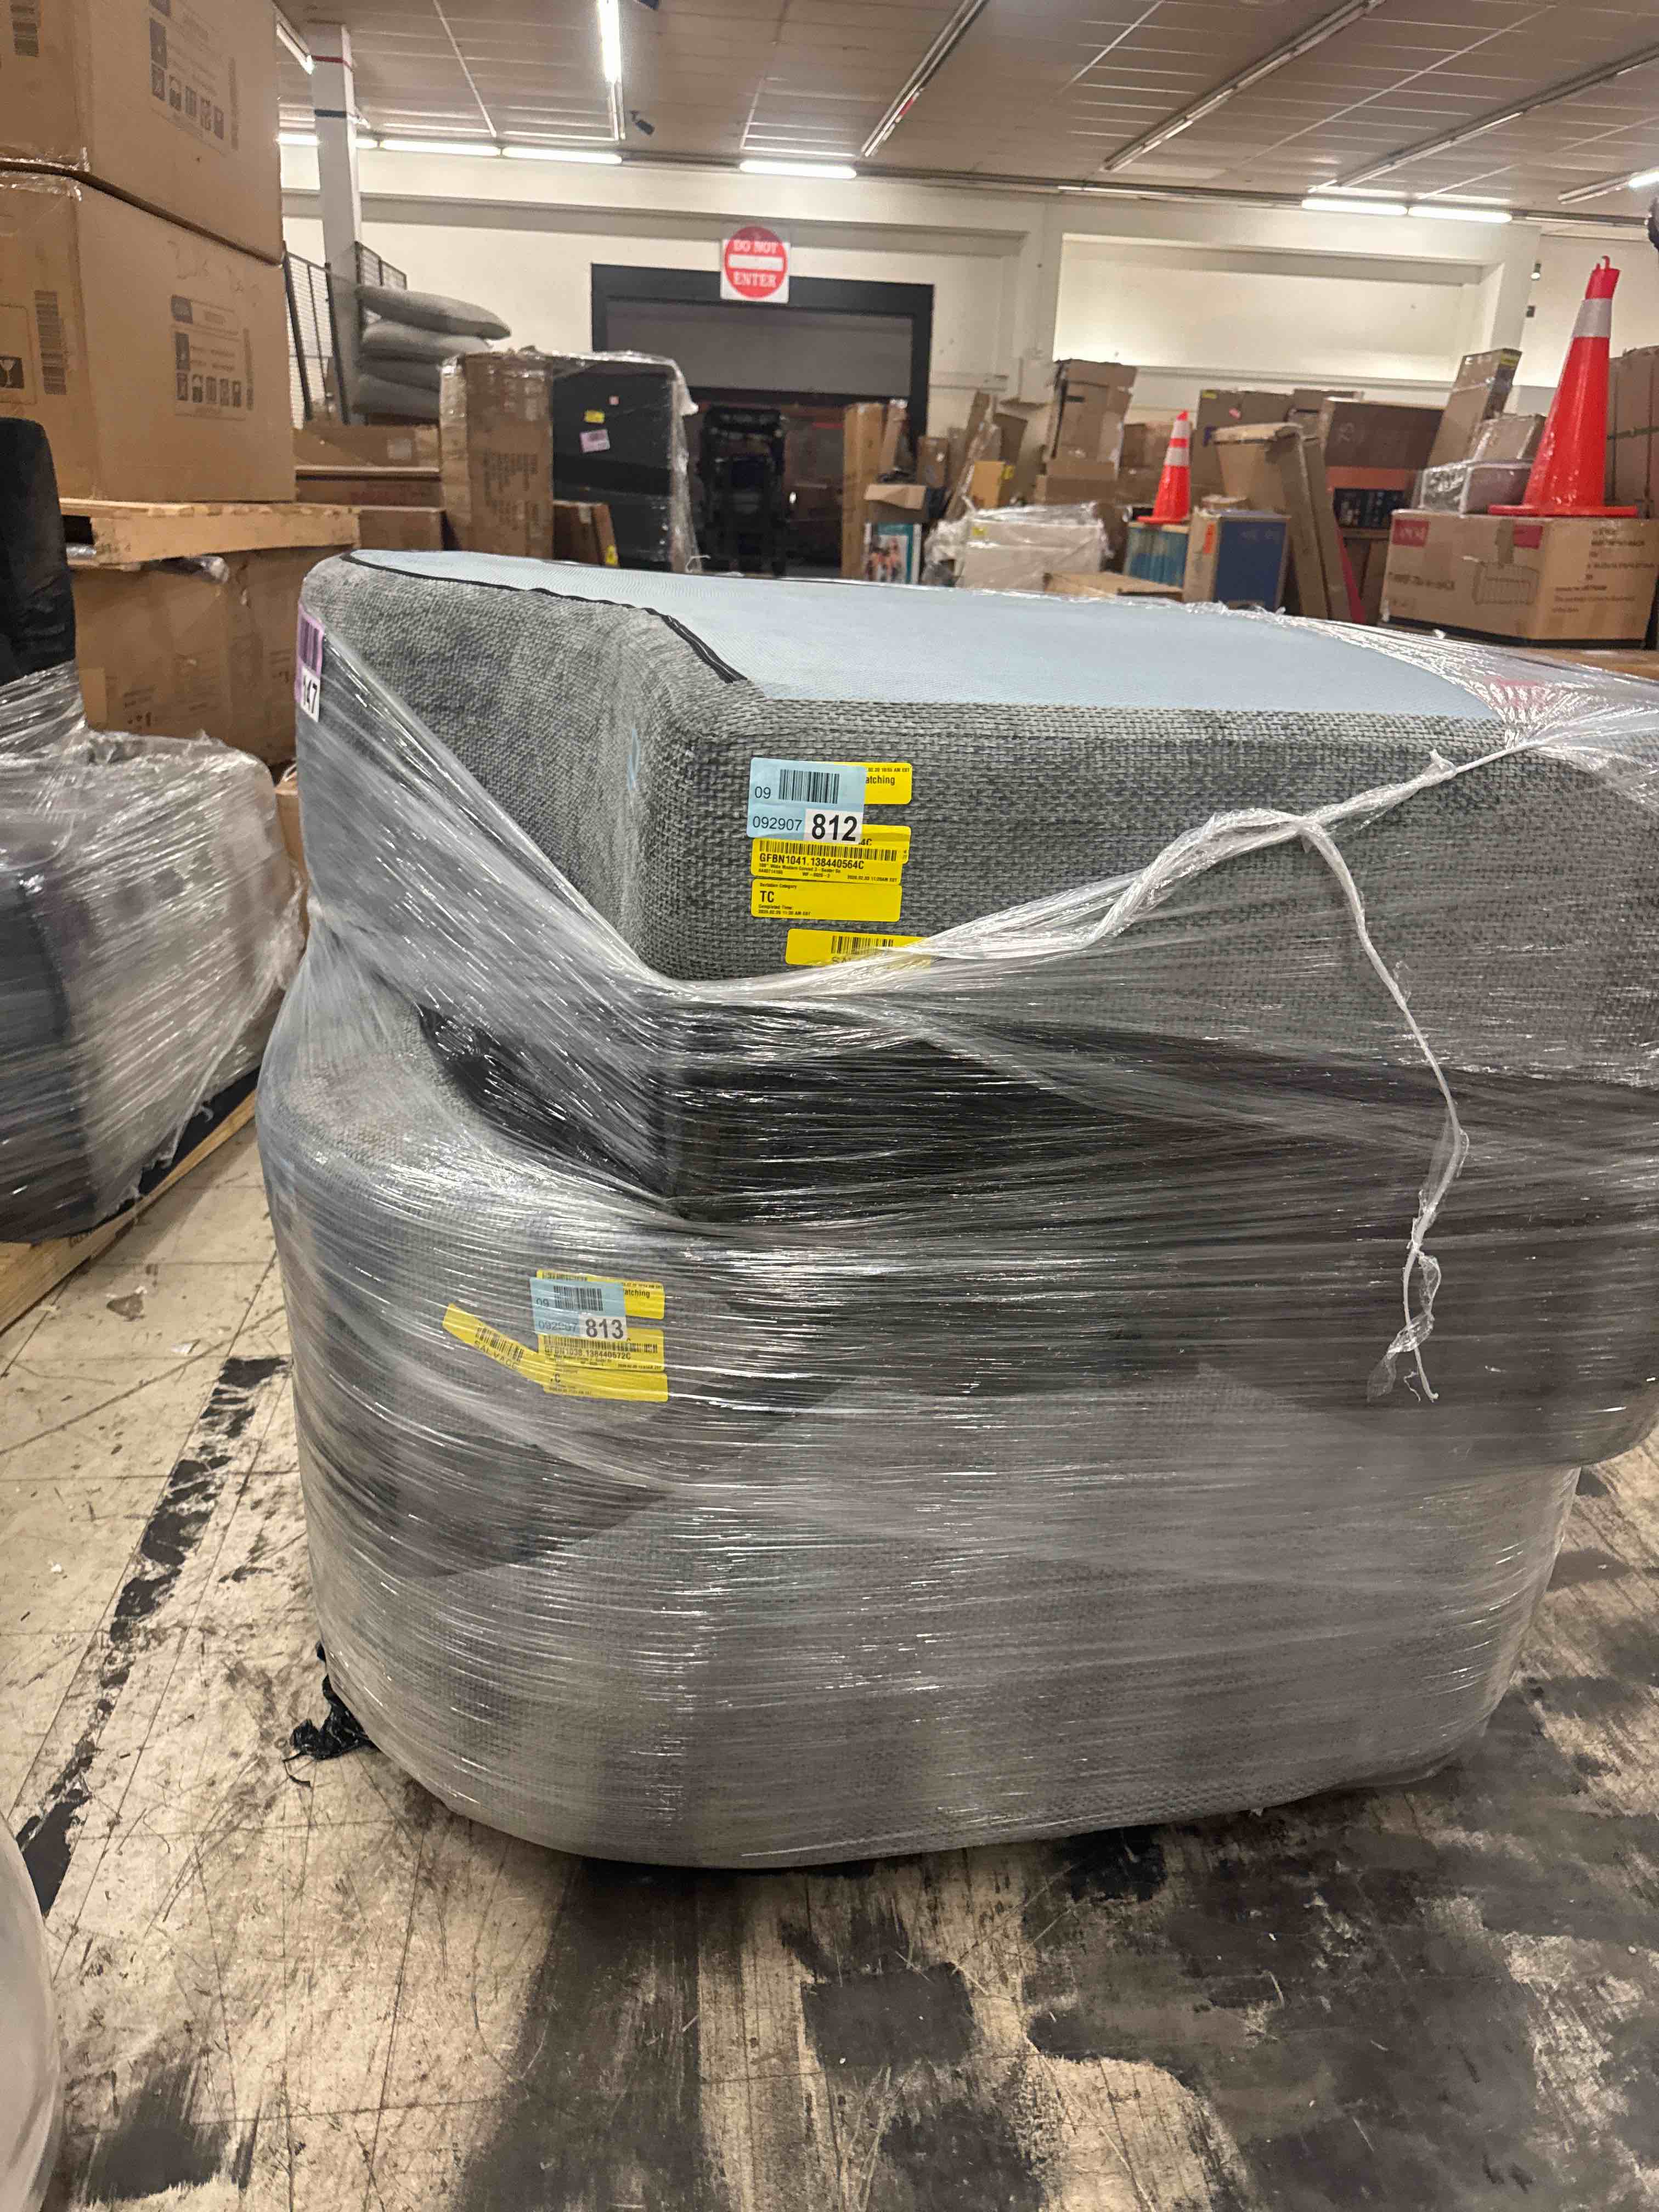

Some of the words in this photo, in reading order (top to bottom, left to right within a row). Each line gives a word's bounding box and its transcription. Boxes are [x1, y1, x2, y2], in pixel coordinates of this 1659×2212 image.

[733, 240, 751, 252] DO
[754, 241, 777, 254] NOT
[733, 271, 777, 287] ENTER
[754, 786, 771, 800] 09
[753, 816, 803, 831] 092907
[811, 813, 858, 842] 812
[760, 890, 775, 902] TC
[585, 1318, 624, 1339] 813
